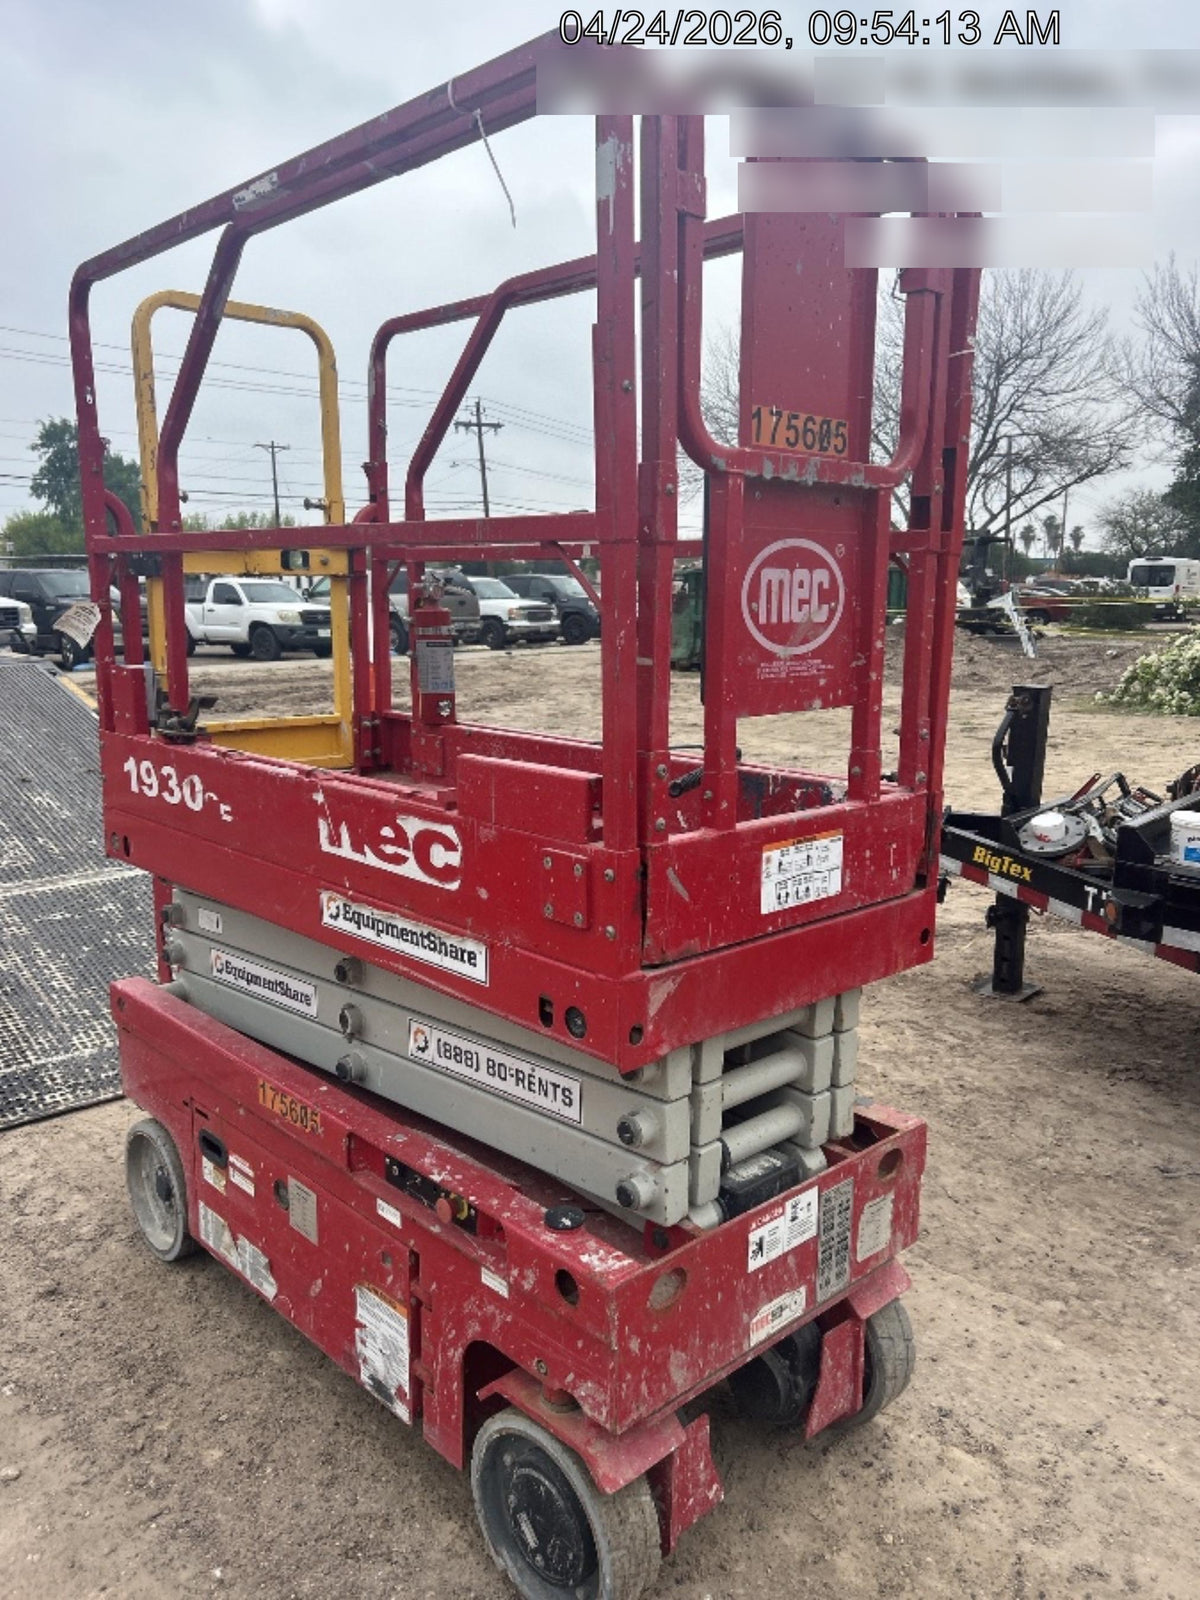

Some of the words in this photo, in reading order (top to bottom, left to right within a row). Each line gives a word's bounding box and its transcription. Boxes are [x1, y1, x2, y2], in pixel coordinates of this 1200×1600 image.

[752, 407, 847, 455] 175605
[972, 845, 1034, 882] BigTex
[342, 903, 478, 968] EquipmentShare
[225, 959, 312, 1007] EquipmentShare
[436, 1037, 481, 1073] (888)
